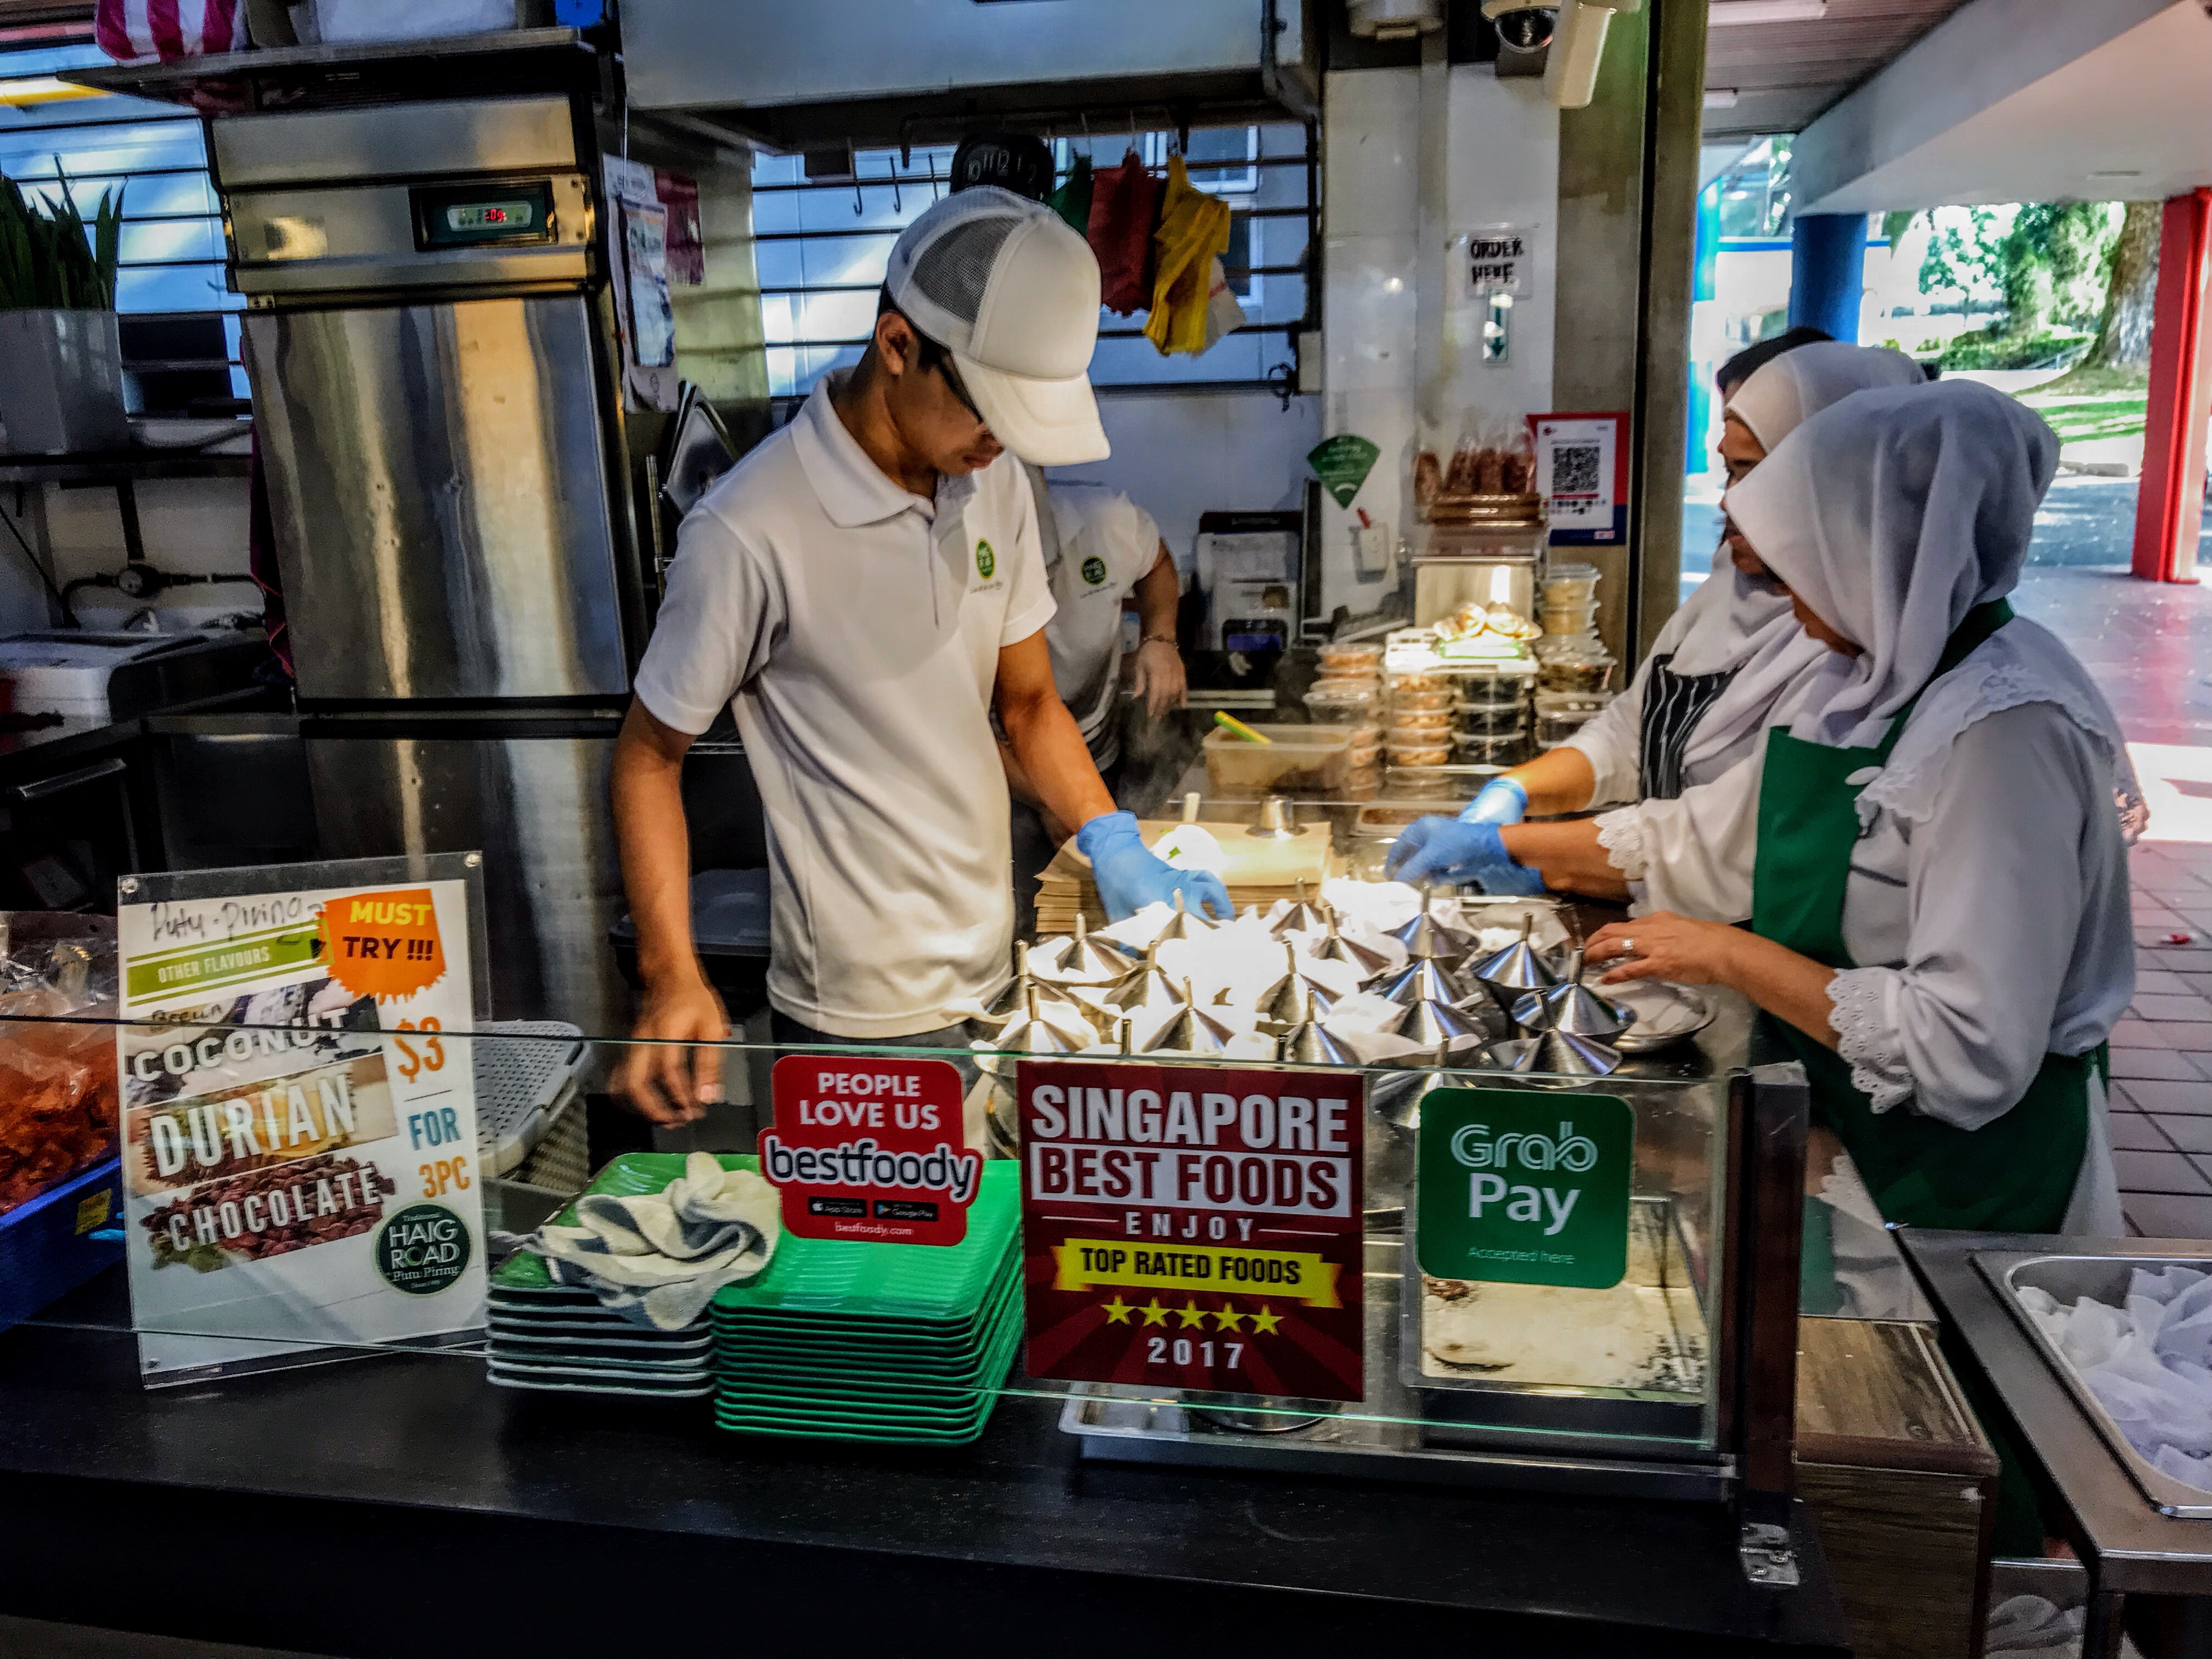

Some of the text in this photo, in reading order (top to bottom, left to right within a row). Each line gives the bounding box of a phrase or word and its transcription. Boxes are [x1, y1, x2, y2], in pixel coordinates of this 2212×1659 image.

[1470, 237, 1524, 259] ORDER
[350, 900, 432, 926] MUST
[158, 946, 271, 984] OTHER FLAVOURS
[342, 935, 435, 961] TRY !!!
[133, 1007, 349, 1082] COCONUT
[393, 1016, 445, 1084] $3
[817, 1073, 922, 1097] PEOPLE
[149, 1073, 359, 1178] DURIAN
[407, 1106, 463, 1151] FOR
[799, 1099, 941, 1130] LOVE US
[1031, 1085, 1350, 1152] SINGAPORE
[1450, 1120, 1599, 1172] Grab
[418, 1155, 471, 1199] 3PC
[766, 1137, 973, 1200] bestfoody
[1041, 1147, 1340, 1210] BEST FOODS
[168, 1166, 384, 1252] CHOCOLATE
[1469, 1172, 1582, 1236] Pay
[388, 1219, 459, 1248] HAIG
[1125, 1211, 1254, 1241] ENJOY
[390, 1242, 461, 1269] ROAD
[1080, 1247, 1301, 1285] TOP RATED FOODS
[1147, 1336, 1245, 1369] 2017
